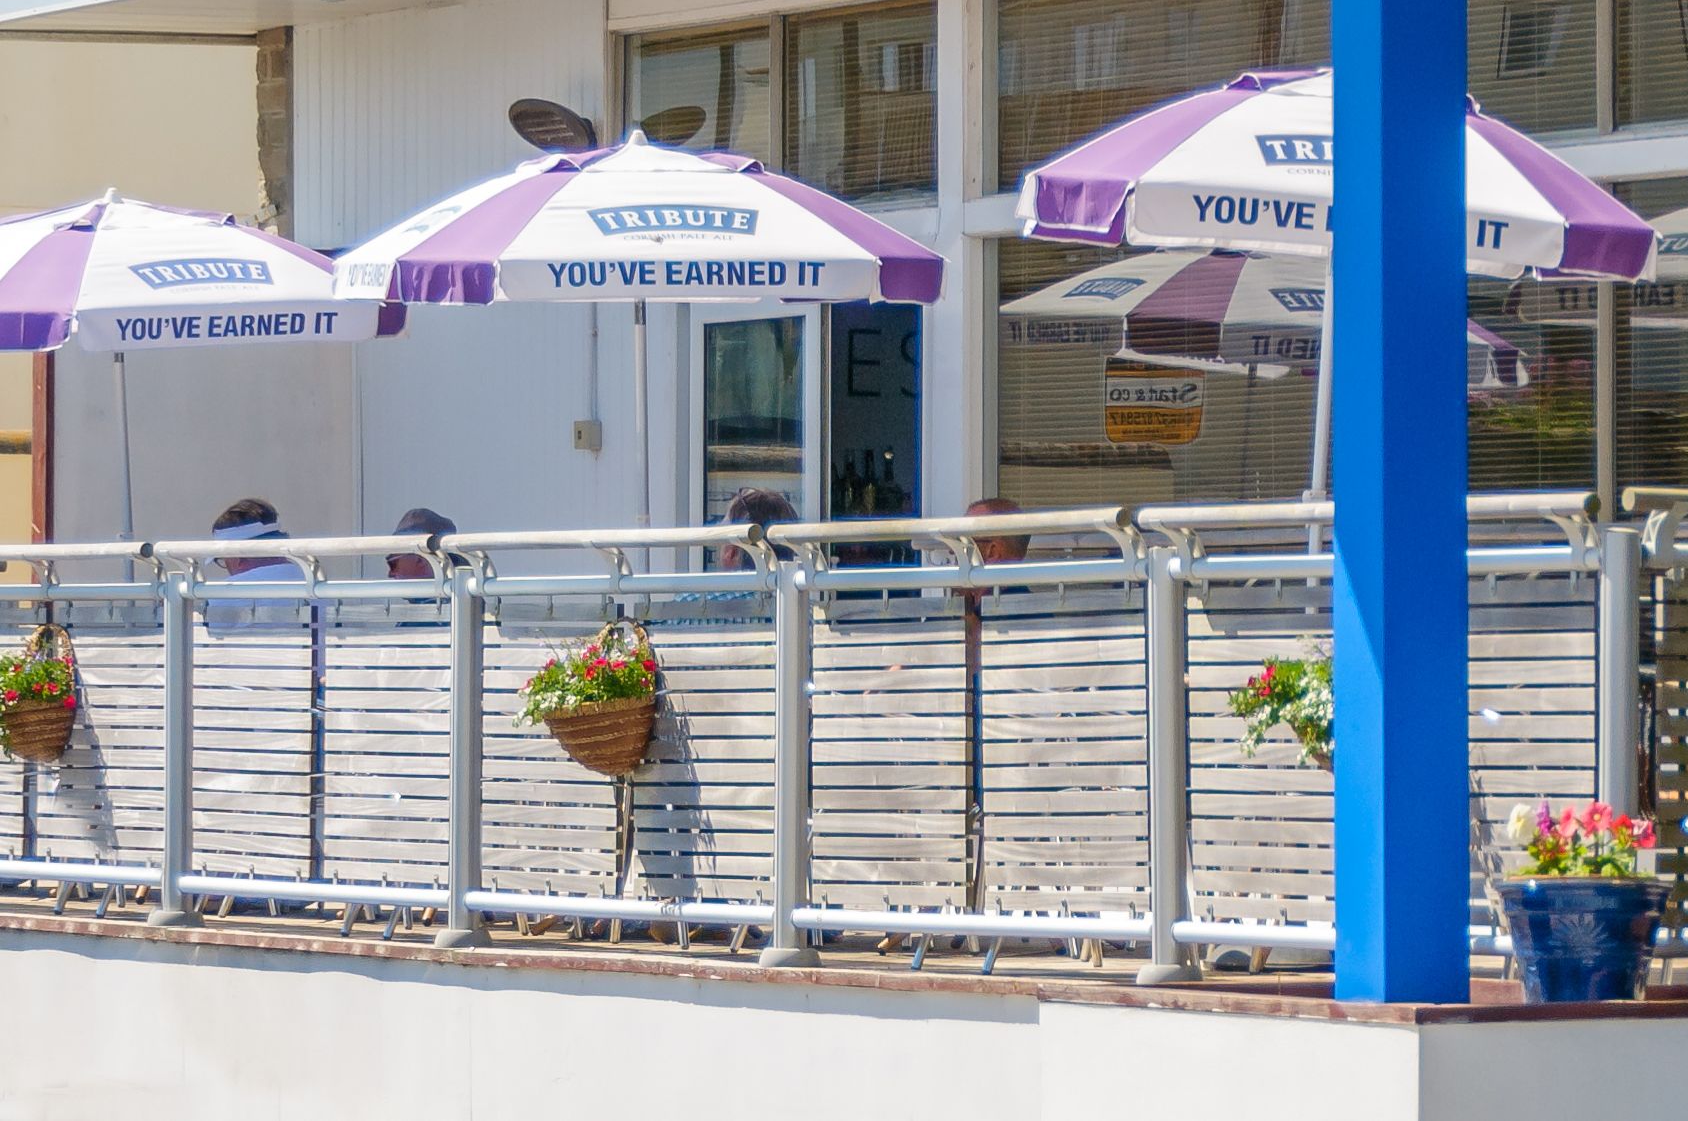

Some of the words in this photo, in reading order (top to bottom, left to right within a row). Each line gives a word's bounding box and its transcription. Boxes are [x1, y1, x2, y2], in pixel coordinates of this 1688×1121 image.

[1286, 167, 1332, 176] CORNI
[596, 208, 751, 231] TRIBUTE
[1192, 194, 1316, 231] YOU'VE
[1477, 219, 1509, 249] IT
[138, 261, 267, 285] TRIBUTE
[547, 260, 657, 288] YOU'VE
[665, 260, 787, 287] EARNED
[798, 261, 826, 287] IT
[116, 316, 203, 341] YOU'VE
[207, 312, 306, 338] EARNED
[314, 312, 339, 335] IT
